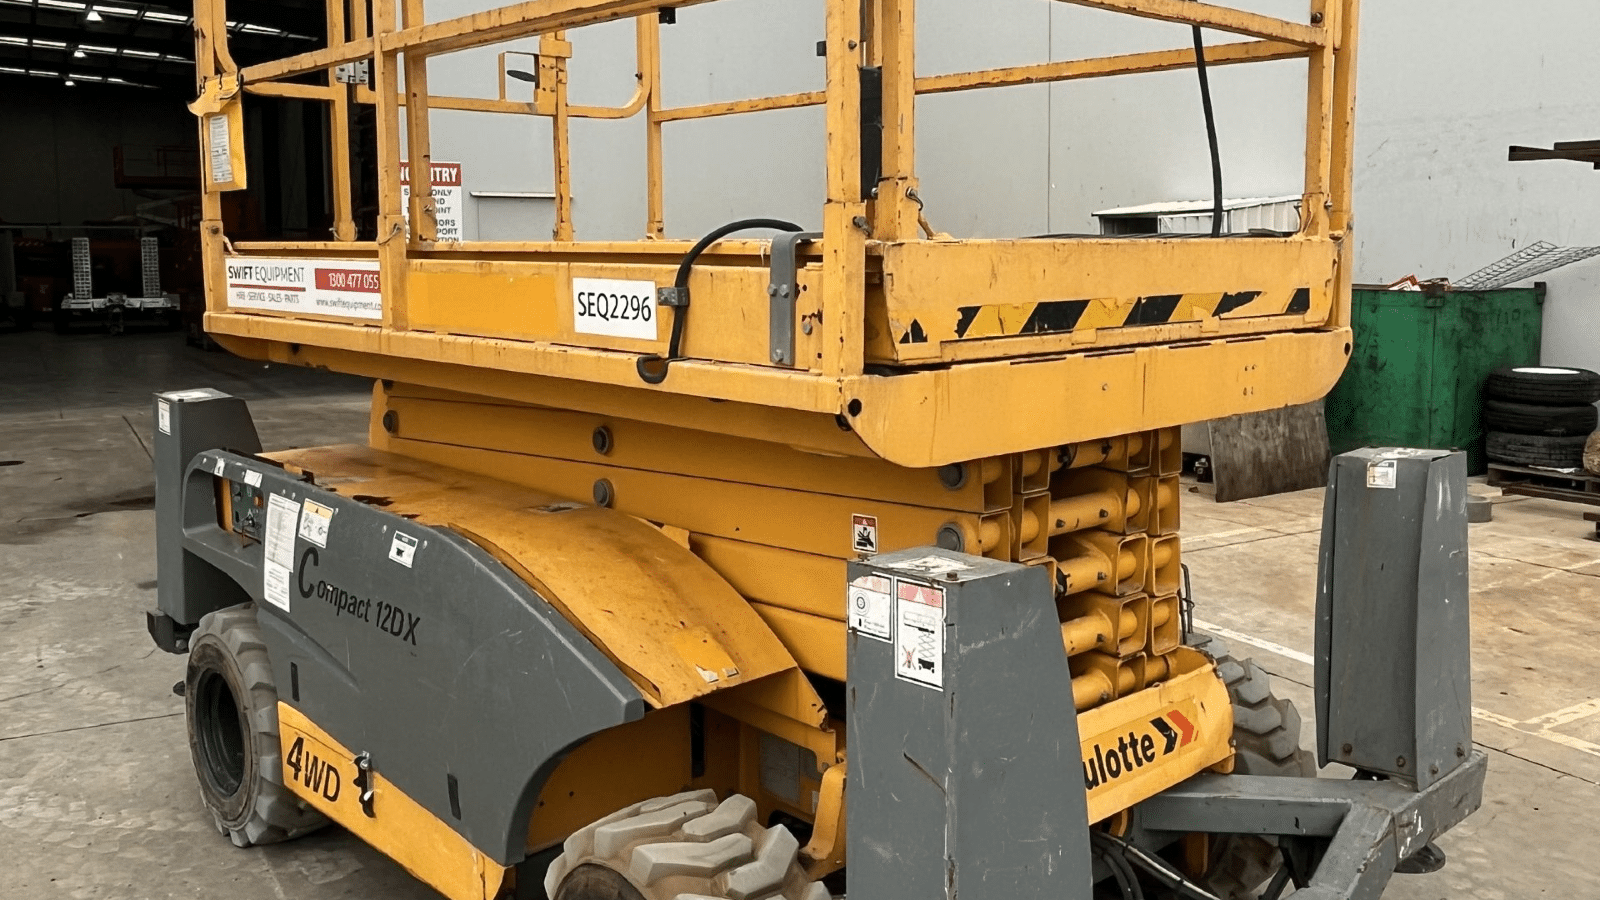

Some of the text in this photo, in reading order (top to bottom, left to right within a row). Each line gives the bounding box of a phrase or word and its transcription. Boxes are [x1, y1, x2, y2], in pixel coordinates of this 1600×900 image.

[431, 189, 453, 197] ONLY
[228, 265, 305, 283] SWIFT EQUIPMENT
[328, 272, 380, 290] 1300 477 055
[578, 291, 652, 322] SEQ2296
[298, 546, 372, 623] Compact
[376, 600, 421, 646] 12DX
[286, 736, 341, 803] 4WD
